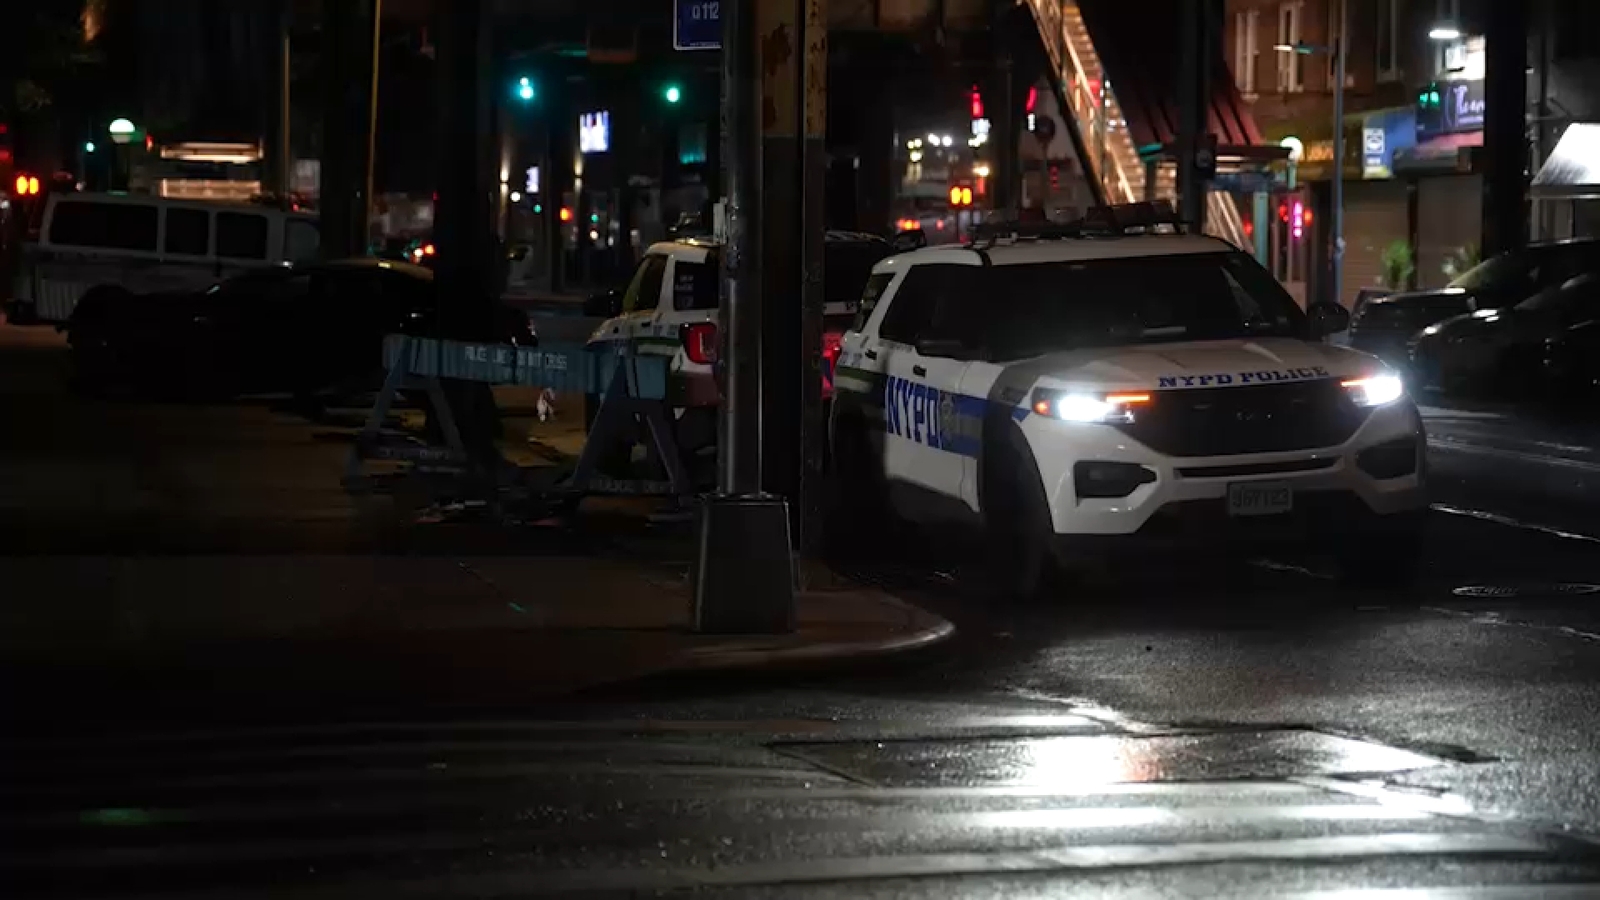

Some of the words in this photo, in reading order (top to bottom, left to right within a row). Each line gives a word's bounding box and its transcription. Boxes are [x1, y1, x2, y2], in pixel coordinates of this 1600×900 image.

[1158, 374, 1233, 388] NYPD
[1239, 366, 1329, 383] POLICE
[887, 375, 940, 449] NYPD
